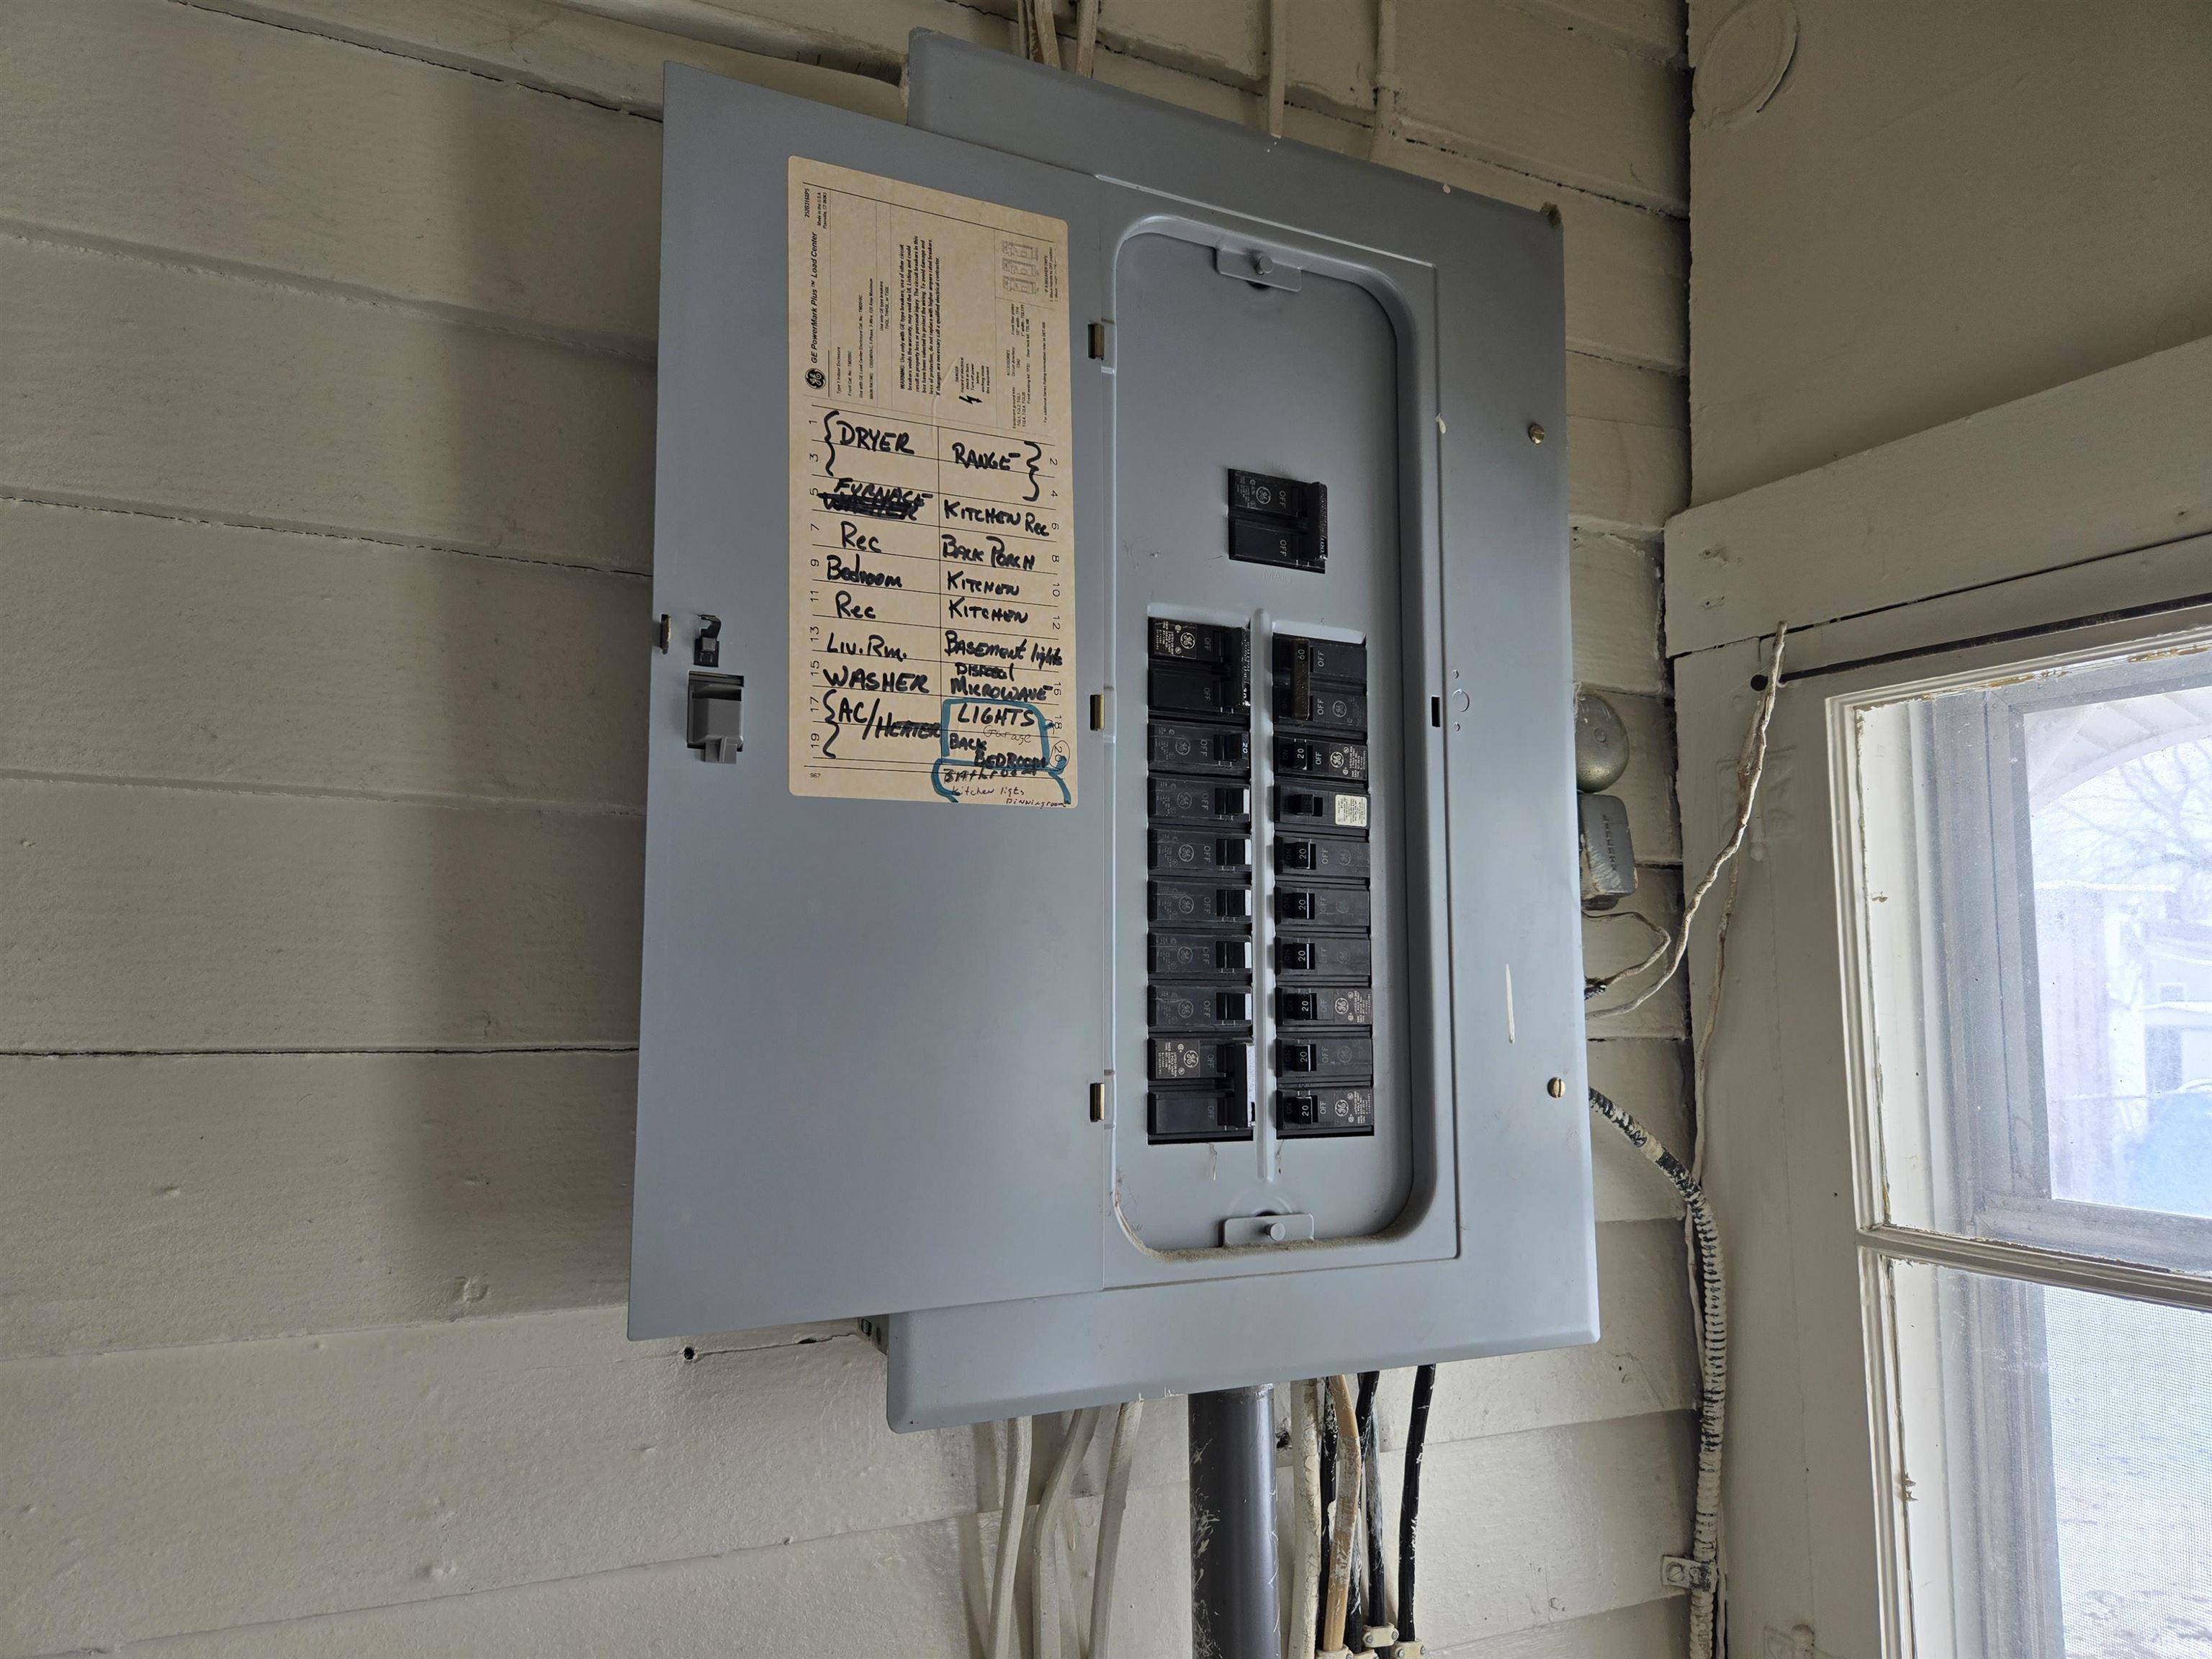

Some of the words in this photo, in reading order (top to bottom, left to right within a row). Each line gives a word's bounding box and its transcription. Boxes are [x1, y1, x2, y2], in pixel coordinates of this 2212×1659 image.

[811, 351, 817, 363] GE
[836, 421, 914, 454] DRYER
[952, 443, 1020, 469] RANGE
[833, 477, 933, 506] FURNACE
[944, 500, 1021, 526] KITCHEN
[1025, 512, 1049, 536] Rec
[841, 521, 882, 553] Rec
[942, 534, 984, 562] BACK
[986, 536, 1035, 570] PORCH
[827, 554, 902, 588] Bedroom
[948, 570, 1020, 596] KITCHEN
[1052, 583, 1061, 597] 10
[810, 590, 820, 601] 11
[835, 590, 876, 619] Rec
[948, 596, 1028, 624] KITCHEN
[1052, 616, 1060, 629] 12
[810, 626, 819, 642] 13
[1298, 649, 1305, 660] 60
[810, 660, 819, 675] 15
[822, 665, 930, 693] WASHER
[950, 676, 1053, 702] MICROWAVE
[1053, 682, 1061, 696] 16
[810, 696, 820, 714] 17
[957, 703, 1035, 727] LIGHTS
[1055, 715, 1061, 729] 18
[811, 733, 819, 748] 19
[949, 732, 986, 751] BACK
[984, 725, 1031, 745] Garage
[1242, 742, 1248, 754] 20
[1297, 747, 1304, 759] 20
[974, 750, 1046, 769] BEDROOM
[1299, 848, 1307, 860] 20
[1298, 899, 1306, 911] 20
[1298, 950, 1306, 961] 20
[1301, 1000, 1309, 1012] 20
[1300, 1051, 1308, 1063] 20
[1302, 1105, 1309, 1117] 20
